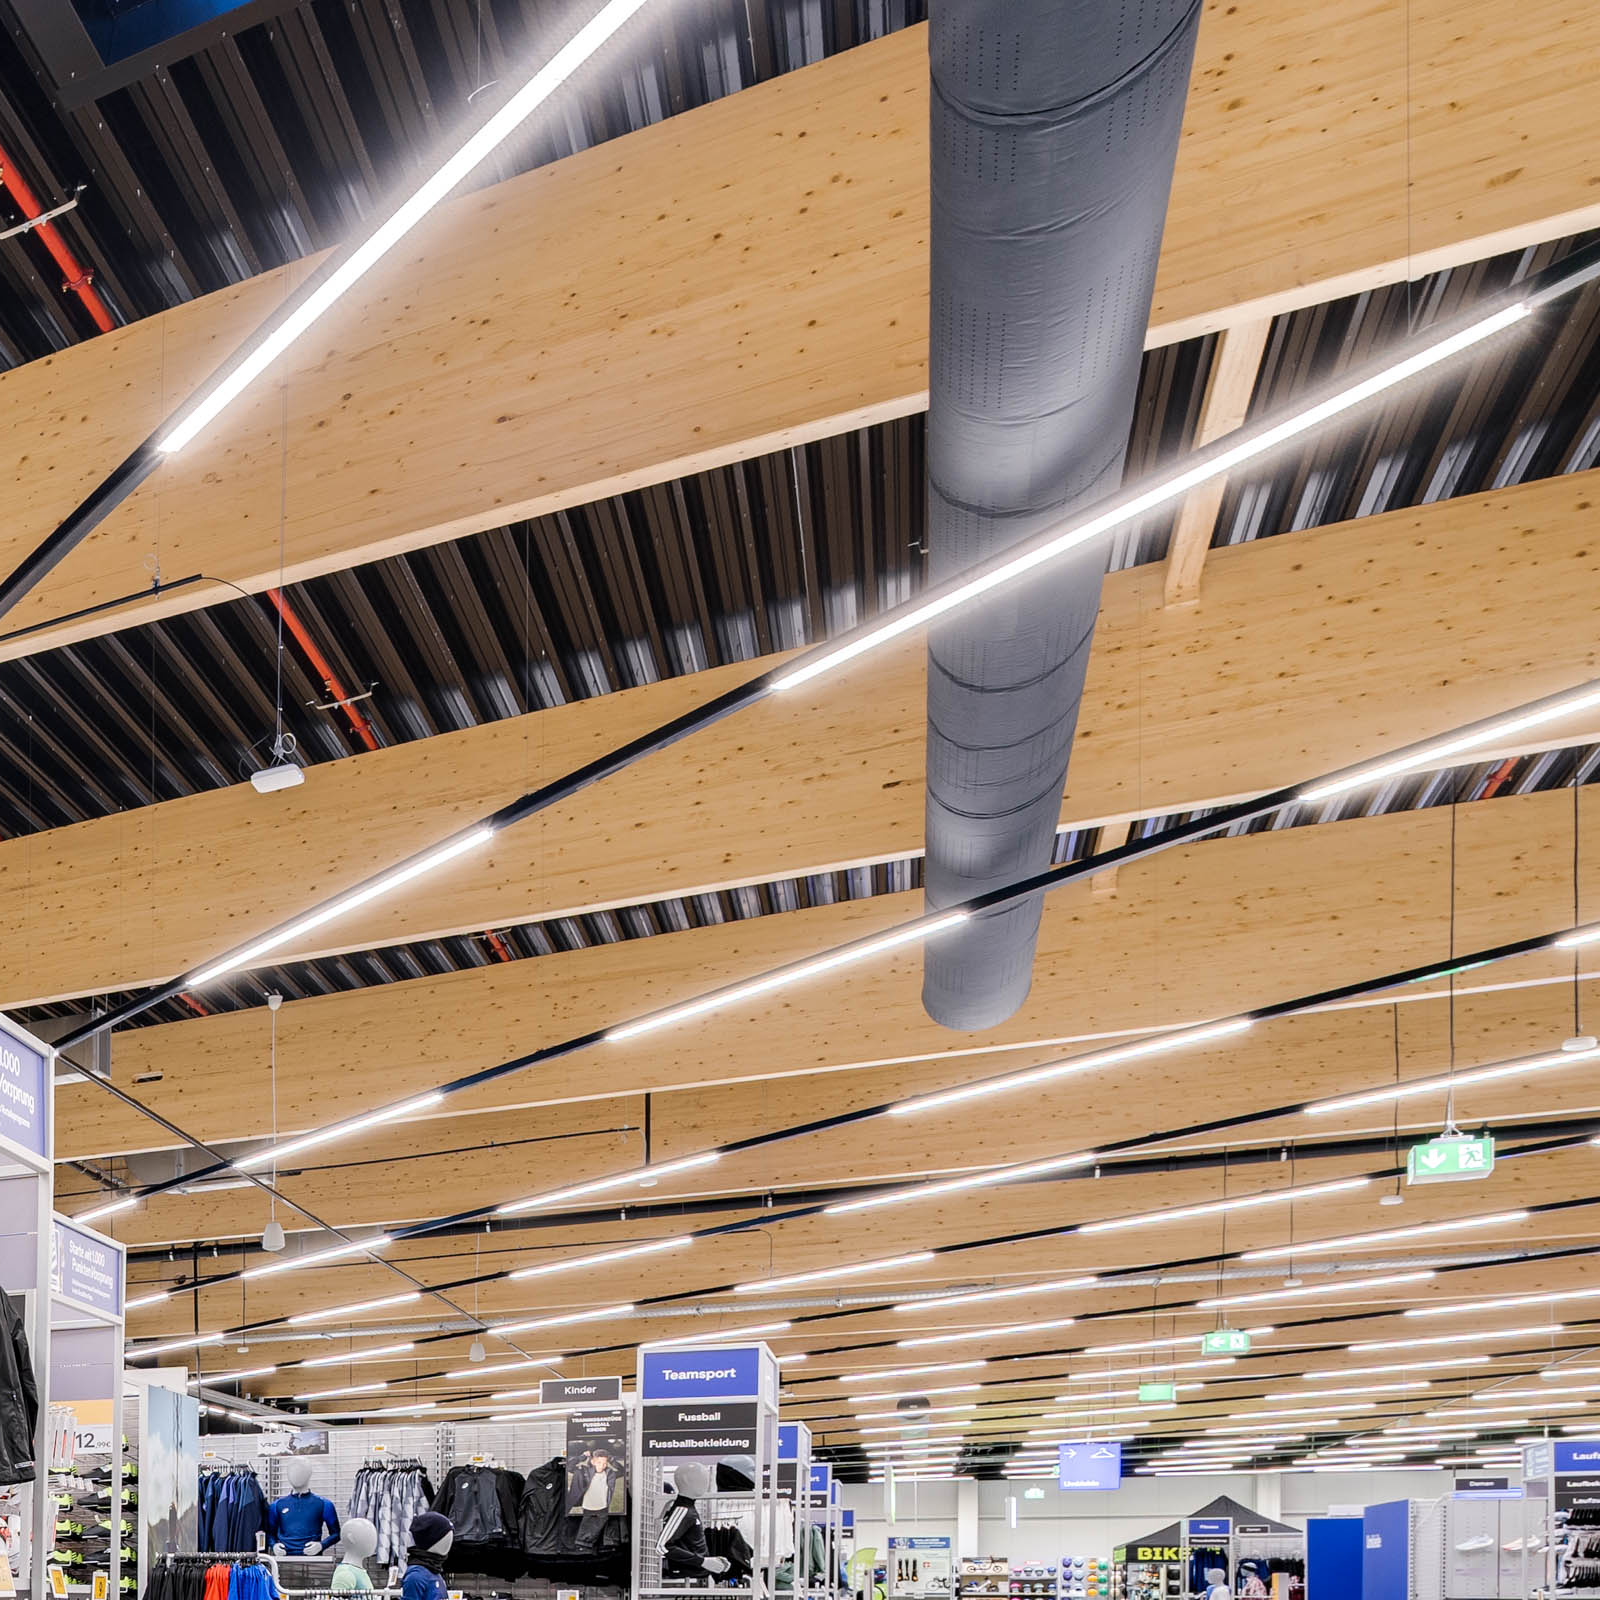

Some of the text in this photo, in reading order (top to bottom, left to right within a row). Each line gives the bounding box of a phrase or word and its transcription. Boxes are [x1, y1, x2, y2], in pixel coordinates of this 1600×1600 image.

[662, 1367, 737, 1381] Teamsport
[564, 1385, 597, 1395] Kinder
[678, 1411, 721, 1422] Fussball
[649, 1438, 750, 1449] Fussballbekleidung
